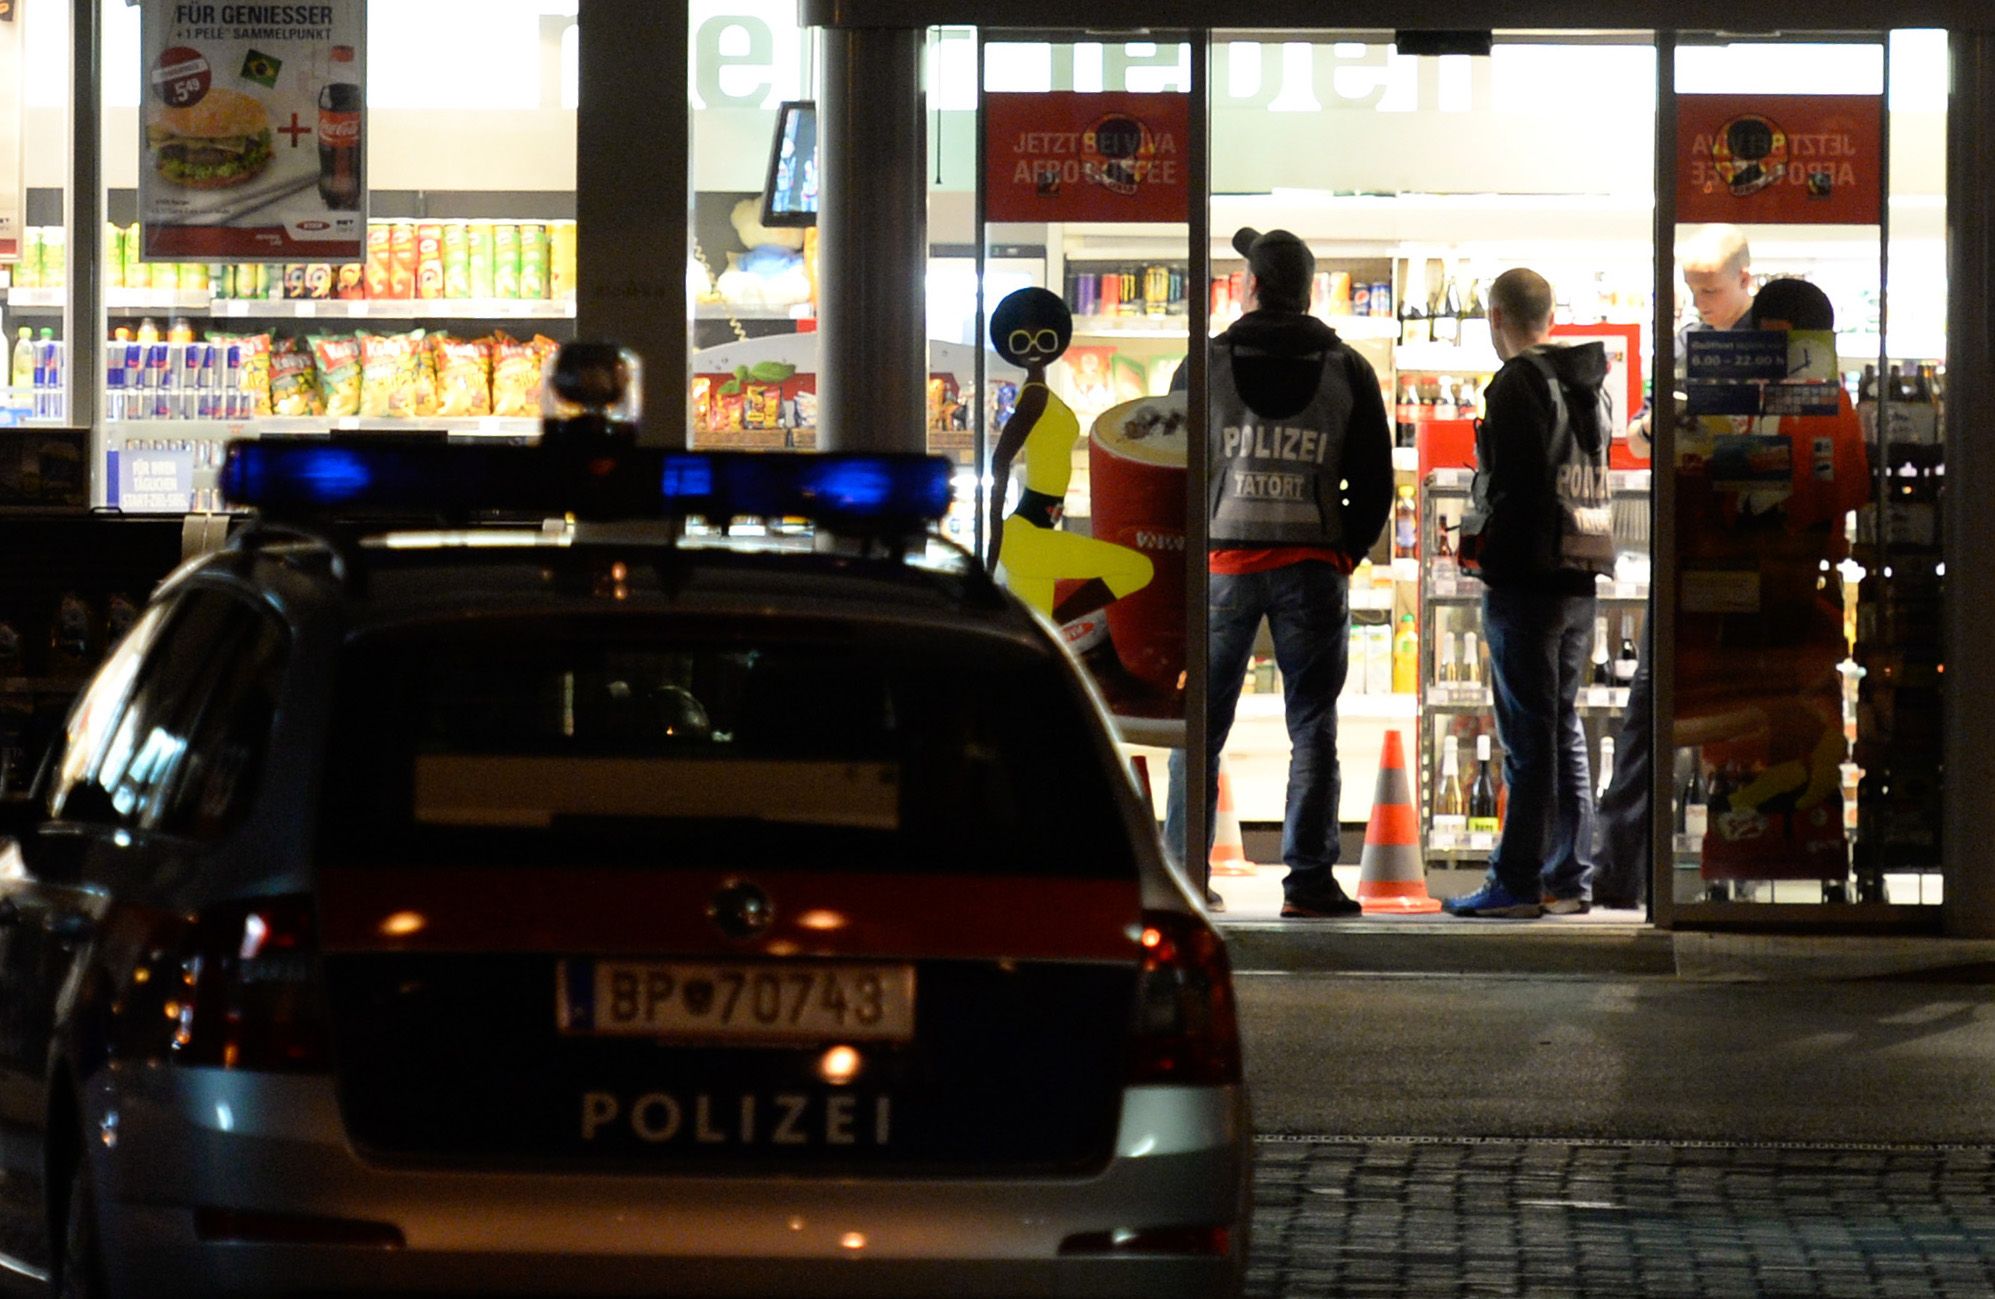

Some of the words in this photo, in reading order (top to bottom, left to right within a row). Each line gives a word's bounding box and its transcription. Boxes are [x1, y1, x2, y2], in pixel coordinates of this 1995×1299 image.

[176, 2, 215, 25] FÜR
[221, 5, 333, 25] GENIESSER
[233, 28, 332, 40] SAMMELPUNKT
[1013, 132, 1079, 153] JETZT
[1013, 160, 1079, 184] AFRO
[1223, 425, 1328, 464] POLIZEI
[1234, 473, 1304, 499] TATORT
[610, 969, 675, 1022] BP
[720, 971, 884, 1025] 70743
[580, 1092, 890, 1146] POLIZEI
